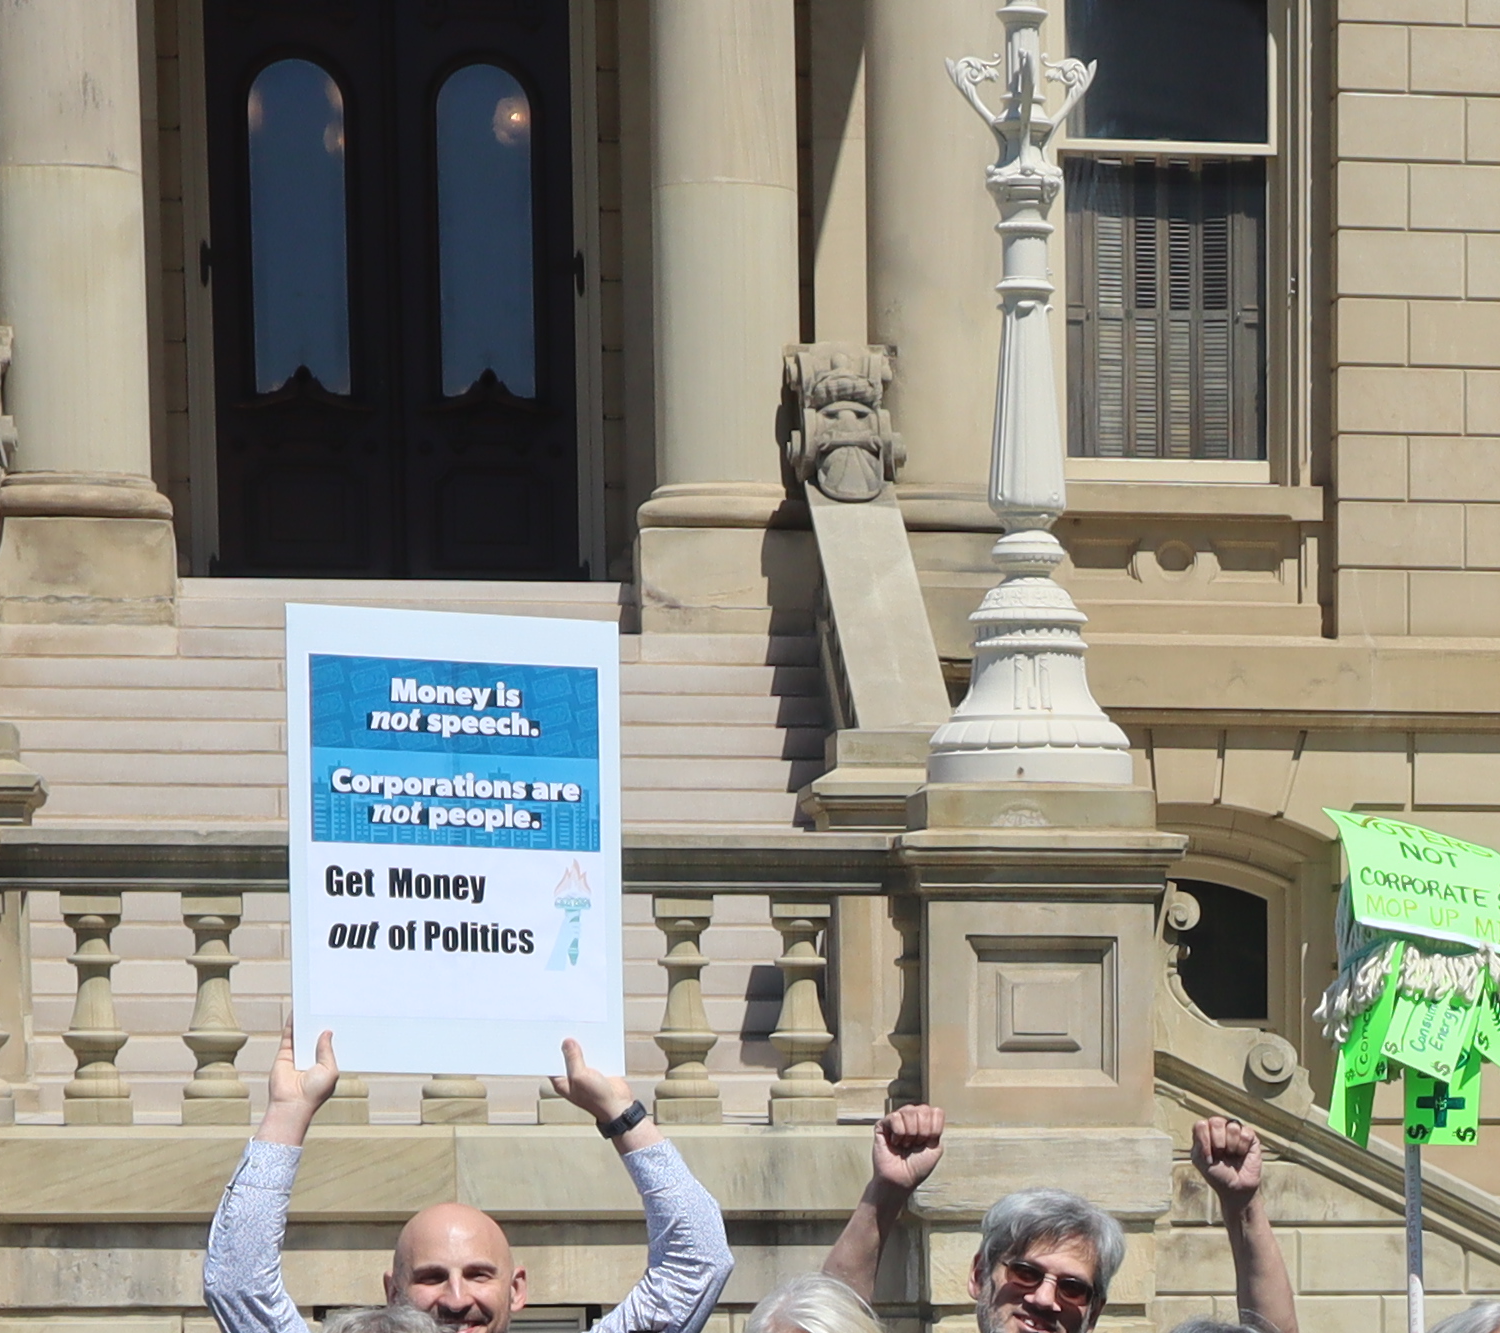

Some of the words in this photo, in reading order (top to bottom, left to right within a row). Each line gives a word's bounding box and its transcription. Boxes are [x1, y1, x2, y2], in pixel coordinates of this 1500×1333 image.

[390, 678, 490, 711] Money
[496, 681, 521, 708] is
[371, 707, 422, 733] not
[427, 712, 540, 738] speech.
[331, 768, 527, 801] Corporations
[532, 778, 581, 802] are
[371, 801, 423, 826] not
[429, 804, 541, 832] people.
[1399, 841, 1458, 869] NOT
[325, 865, 375, 898] Get
[388, 867, 486, 904] Money
[1359, 866, 1489, 909] CORPORATE
[1365, 894, 1419, 919] MOP
[1429, 906, 1460, 928] UP
[328, 921, 380, 951] out
[388, 920, 417, 951] of
[424, 921, 534, 955] Politics
